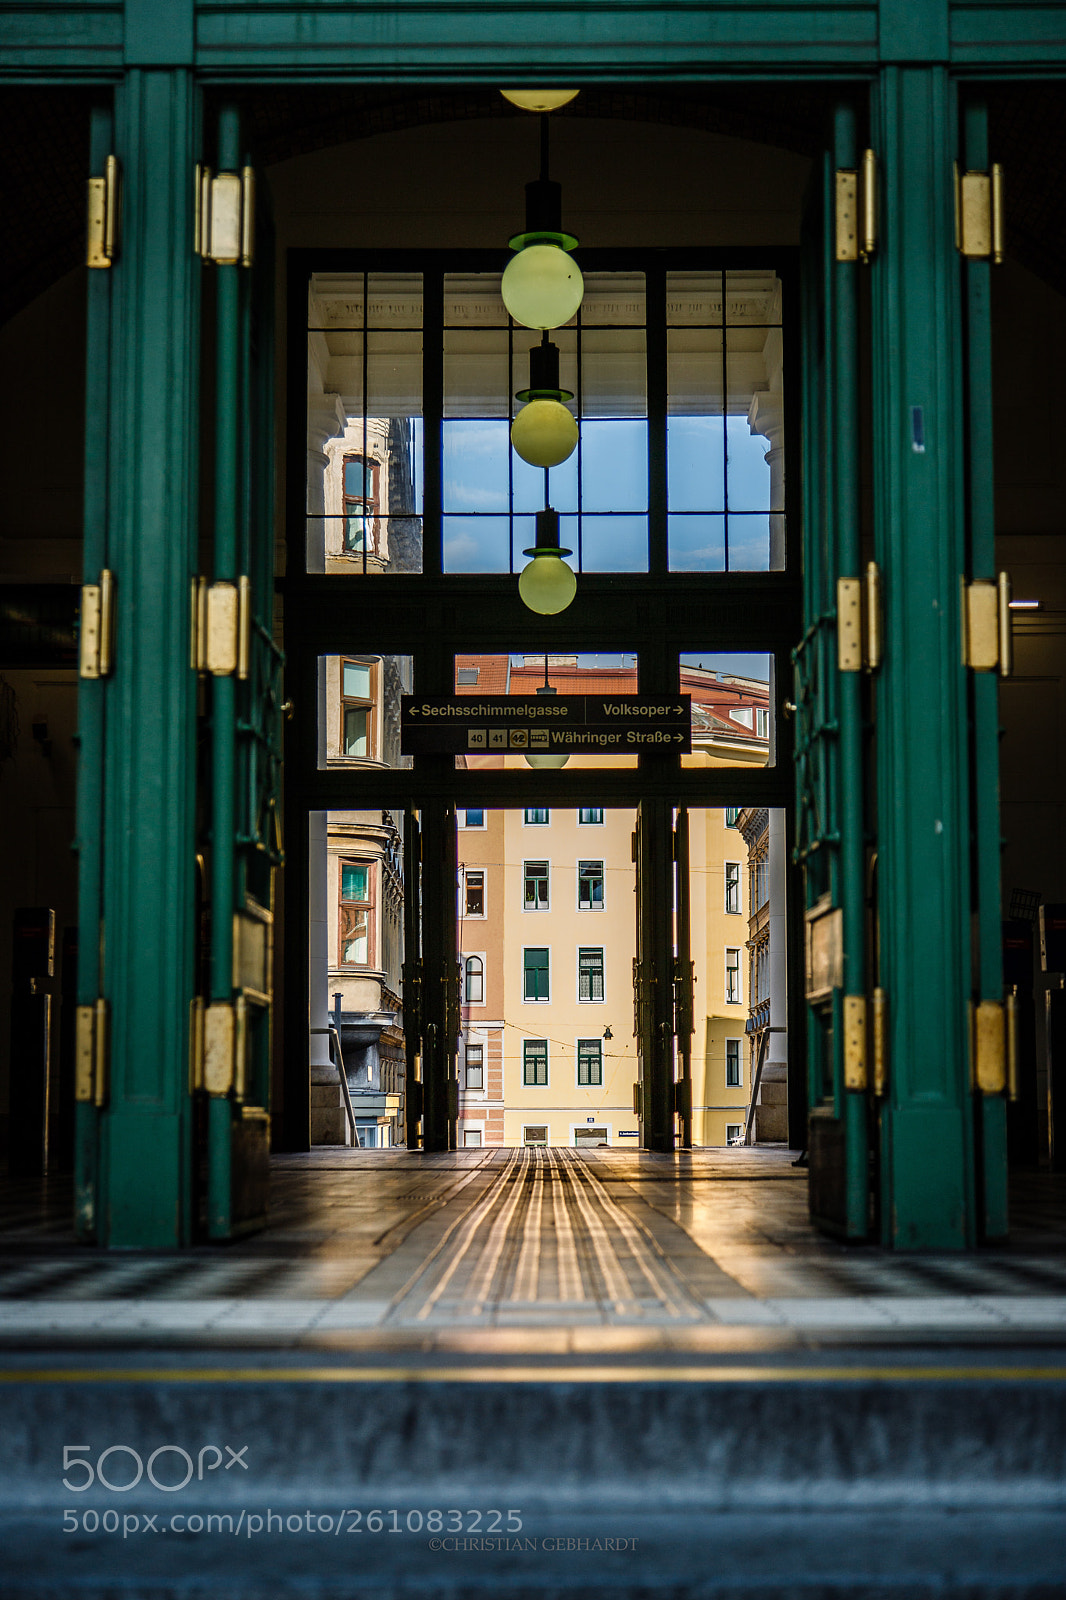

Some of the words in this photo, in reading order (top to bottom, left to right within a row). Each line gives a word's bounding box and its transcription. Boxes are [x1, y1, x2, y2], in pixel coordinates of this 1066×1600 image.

[421, 704, 568, 718] Sechsschimmelgasse
[603, 703, 671, 717] Volksoper
[471, 734, 483, 743] 40
[552, 731, 622, 745] Währinger
[626, 731, 671, 743] Straße
